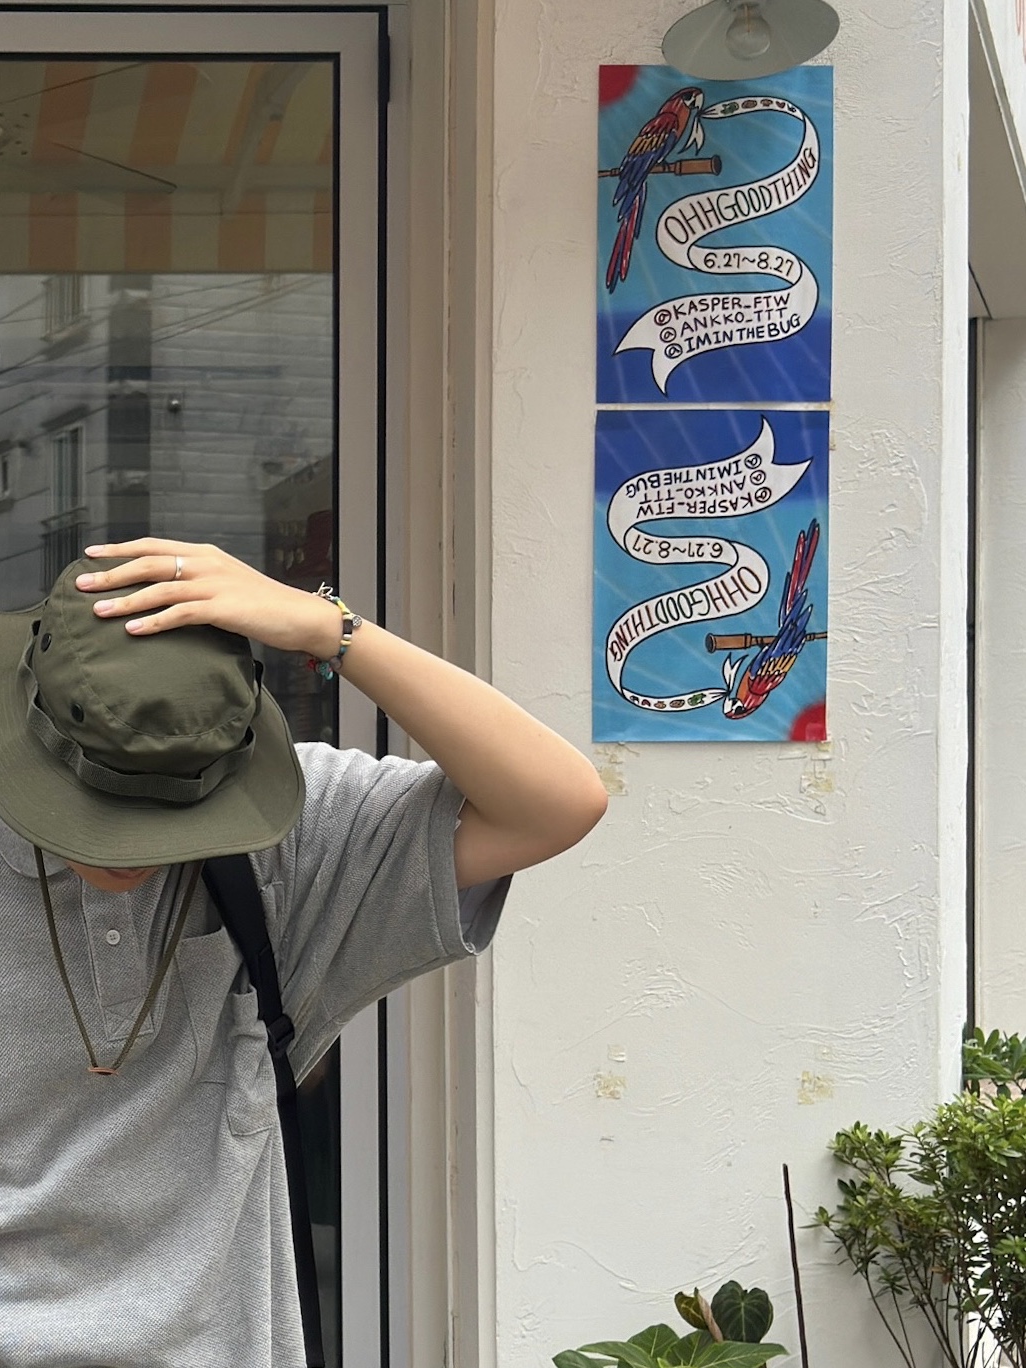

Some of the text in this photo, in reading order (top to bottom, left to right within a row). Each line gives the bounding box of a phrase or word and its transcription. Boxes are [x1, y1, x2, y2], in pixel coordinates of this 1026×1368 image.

[664, 147, 817, 245] OHHGOODTHING
[703, 252, 794, 277] 6.27~8.27
[654, 292, 790, 327] @KASPER_FTW
[636, 486, 772, 519] @KASPER_FTW
[632, 534, 724, 559] 6.27~8.27
[608, 566, 762, 662] OHHGOODTHING
